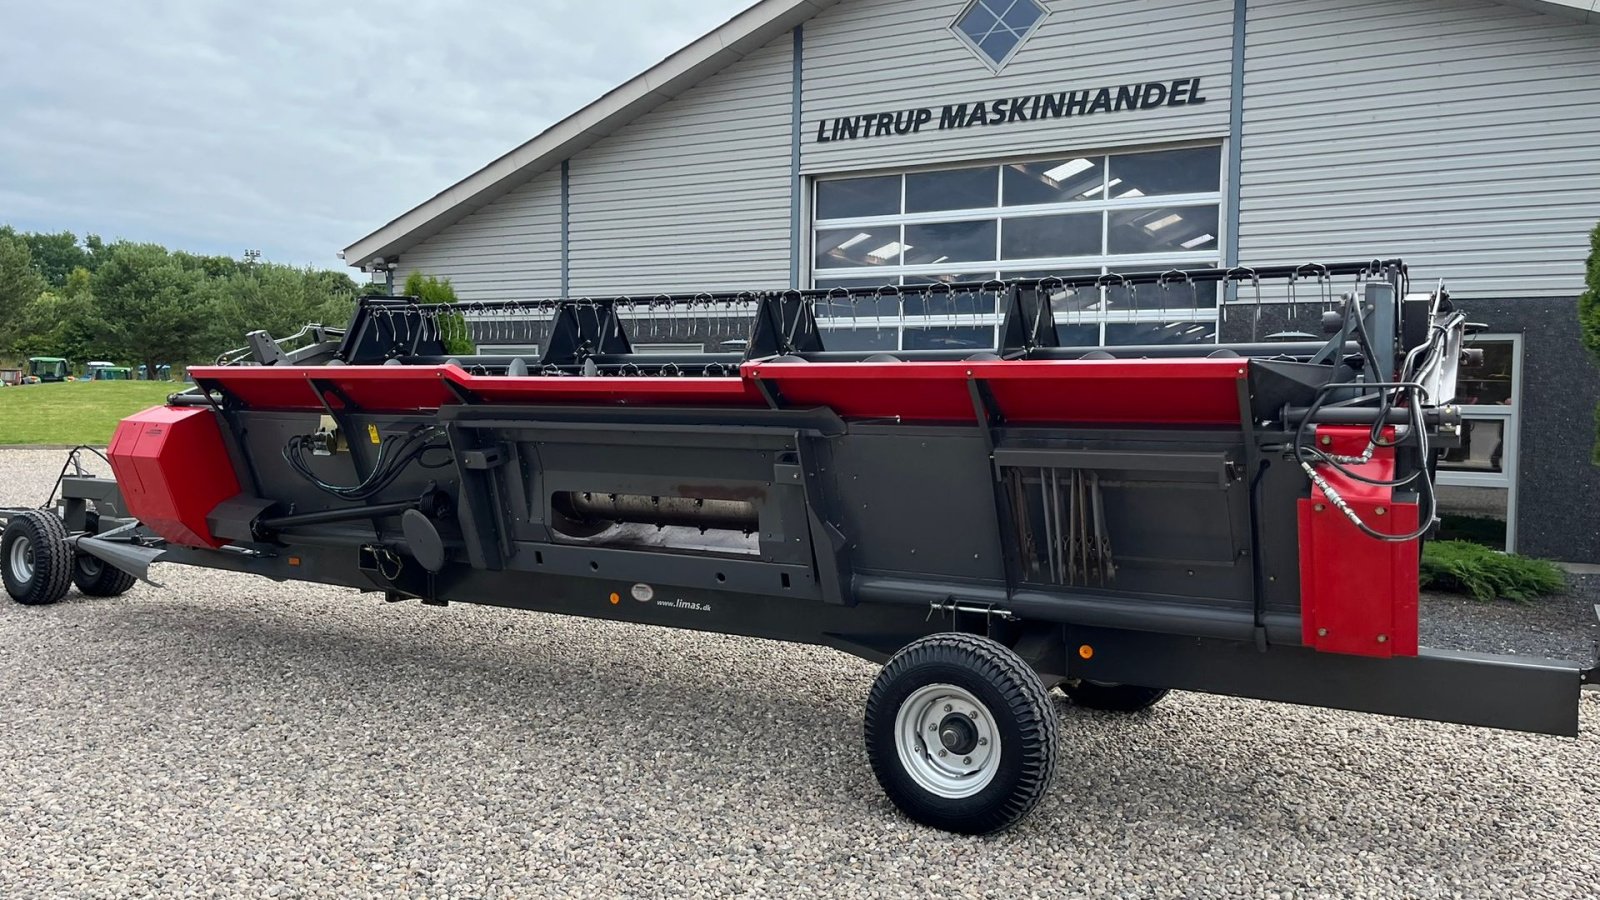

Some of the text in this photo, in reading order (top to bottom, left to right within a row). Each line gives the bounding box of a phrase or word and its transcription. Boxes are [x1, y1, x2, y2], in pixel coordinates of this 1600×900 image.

[816, 78, 1207, 143] LINTRUP MASKINHANDEL
[656, 598, 712, 611] www.limas.dk
